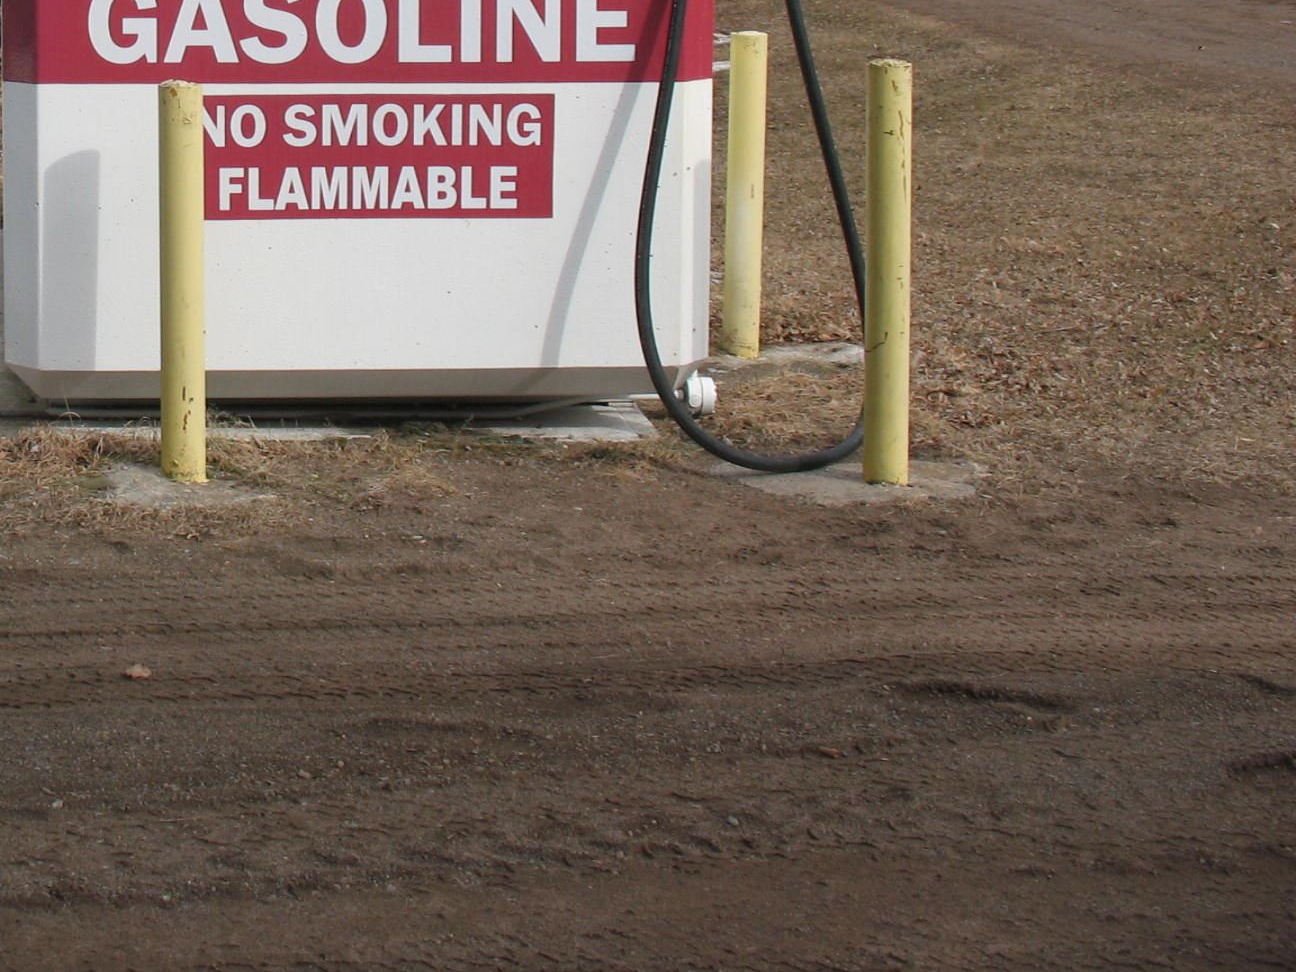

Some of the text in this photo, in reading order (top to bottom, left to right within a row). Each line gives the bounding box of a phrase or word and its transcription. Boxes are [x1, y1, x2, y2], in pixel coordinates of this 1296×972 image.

[202, 103, 542, 148] NO SMOKING
[218, 166, 519, 212] FLAMMABLE
